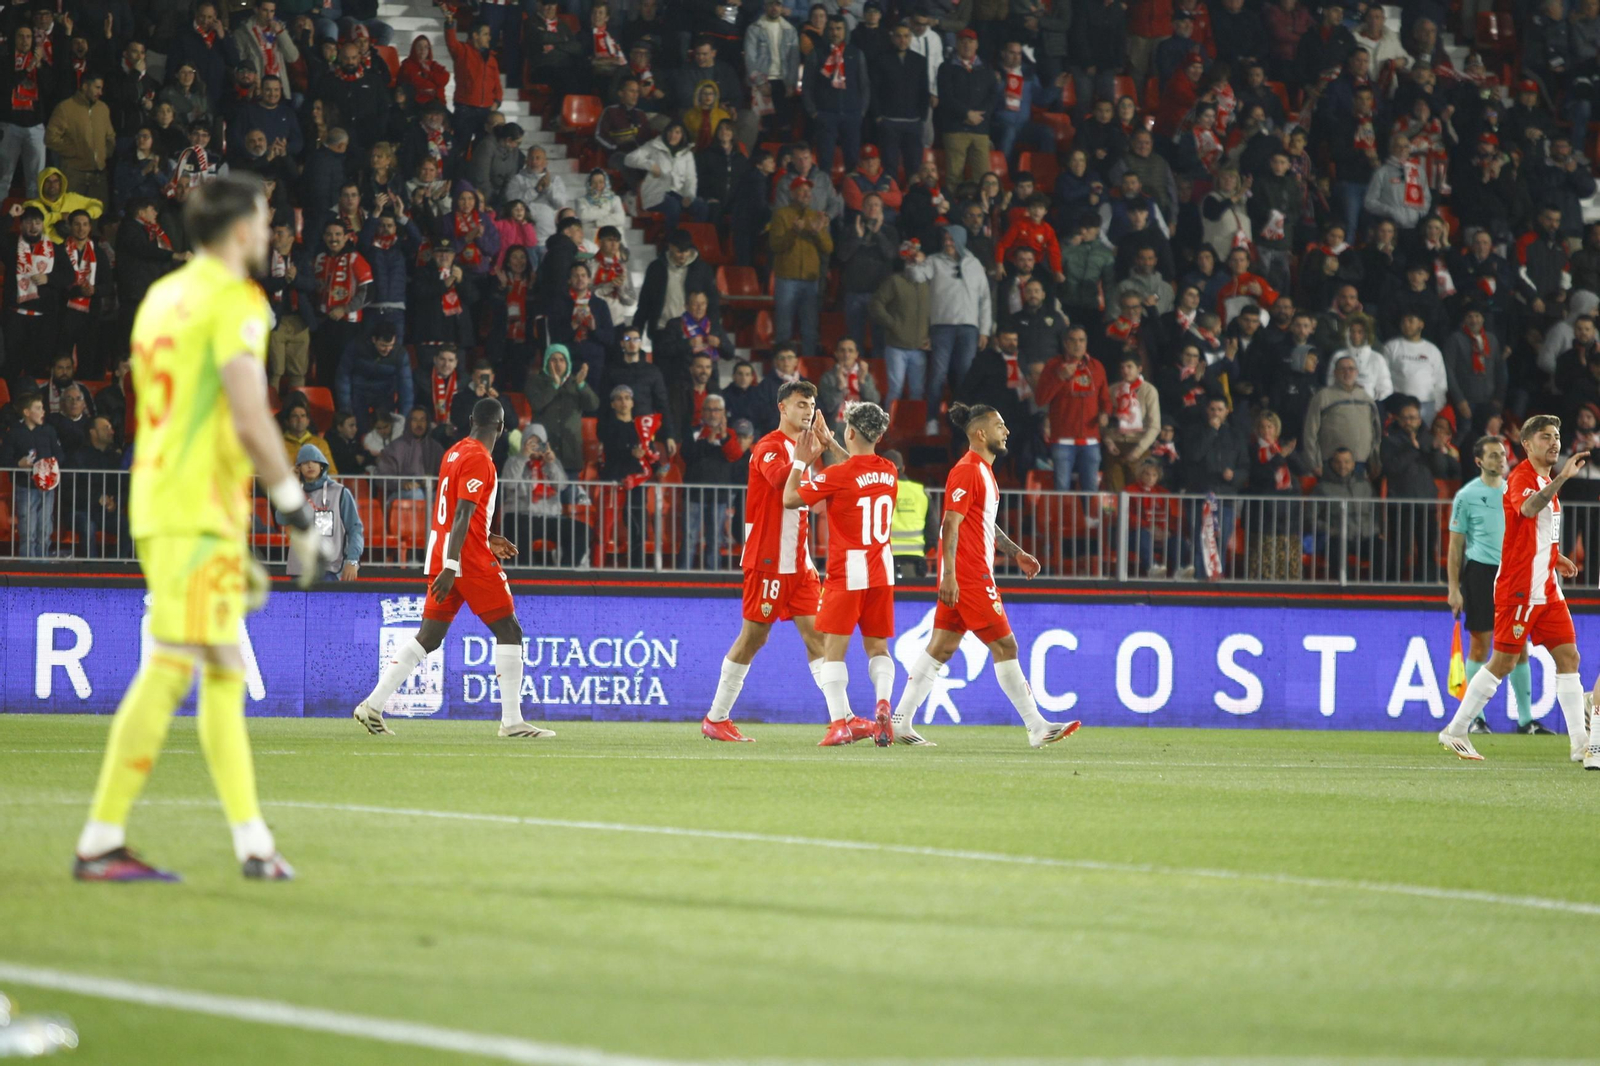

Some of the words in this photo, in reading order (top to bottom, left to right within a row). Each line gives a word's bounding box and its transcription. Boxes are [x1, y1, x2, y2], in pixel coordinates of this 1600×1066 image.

[855, 472, 879, 489] NICO
[437, 476, 449, 525] 6
[856, 494, 893, 546] 10
[762, 579, 780, 600] 18
[462, 630, 679, 668] DIUTACIÓN
[519, 668, 669, 705] ALMERÍA
[1030, 628, 1445, 719] COSTA
